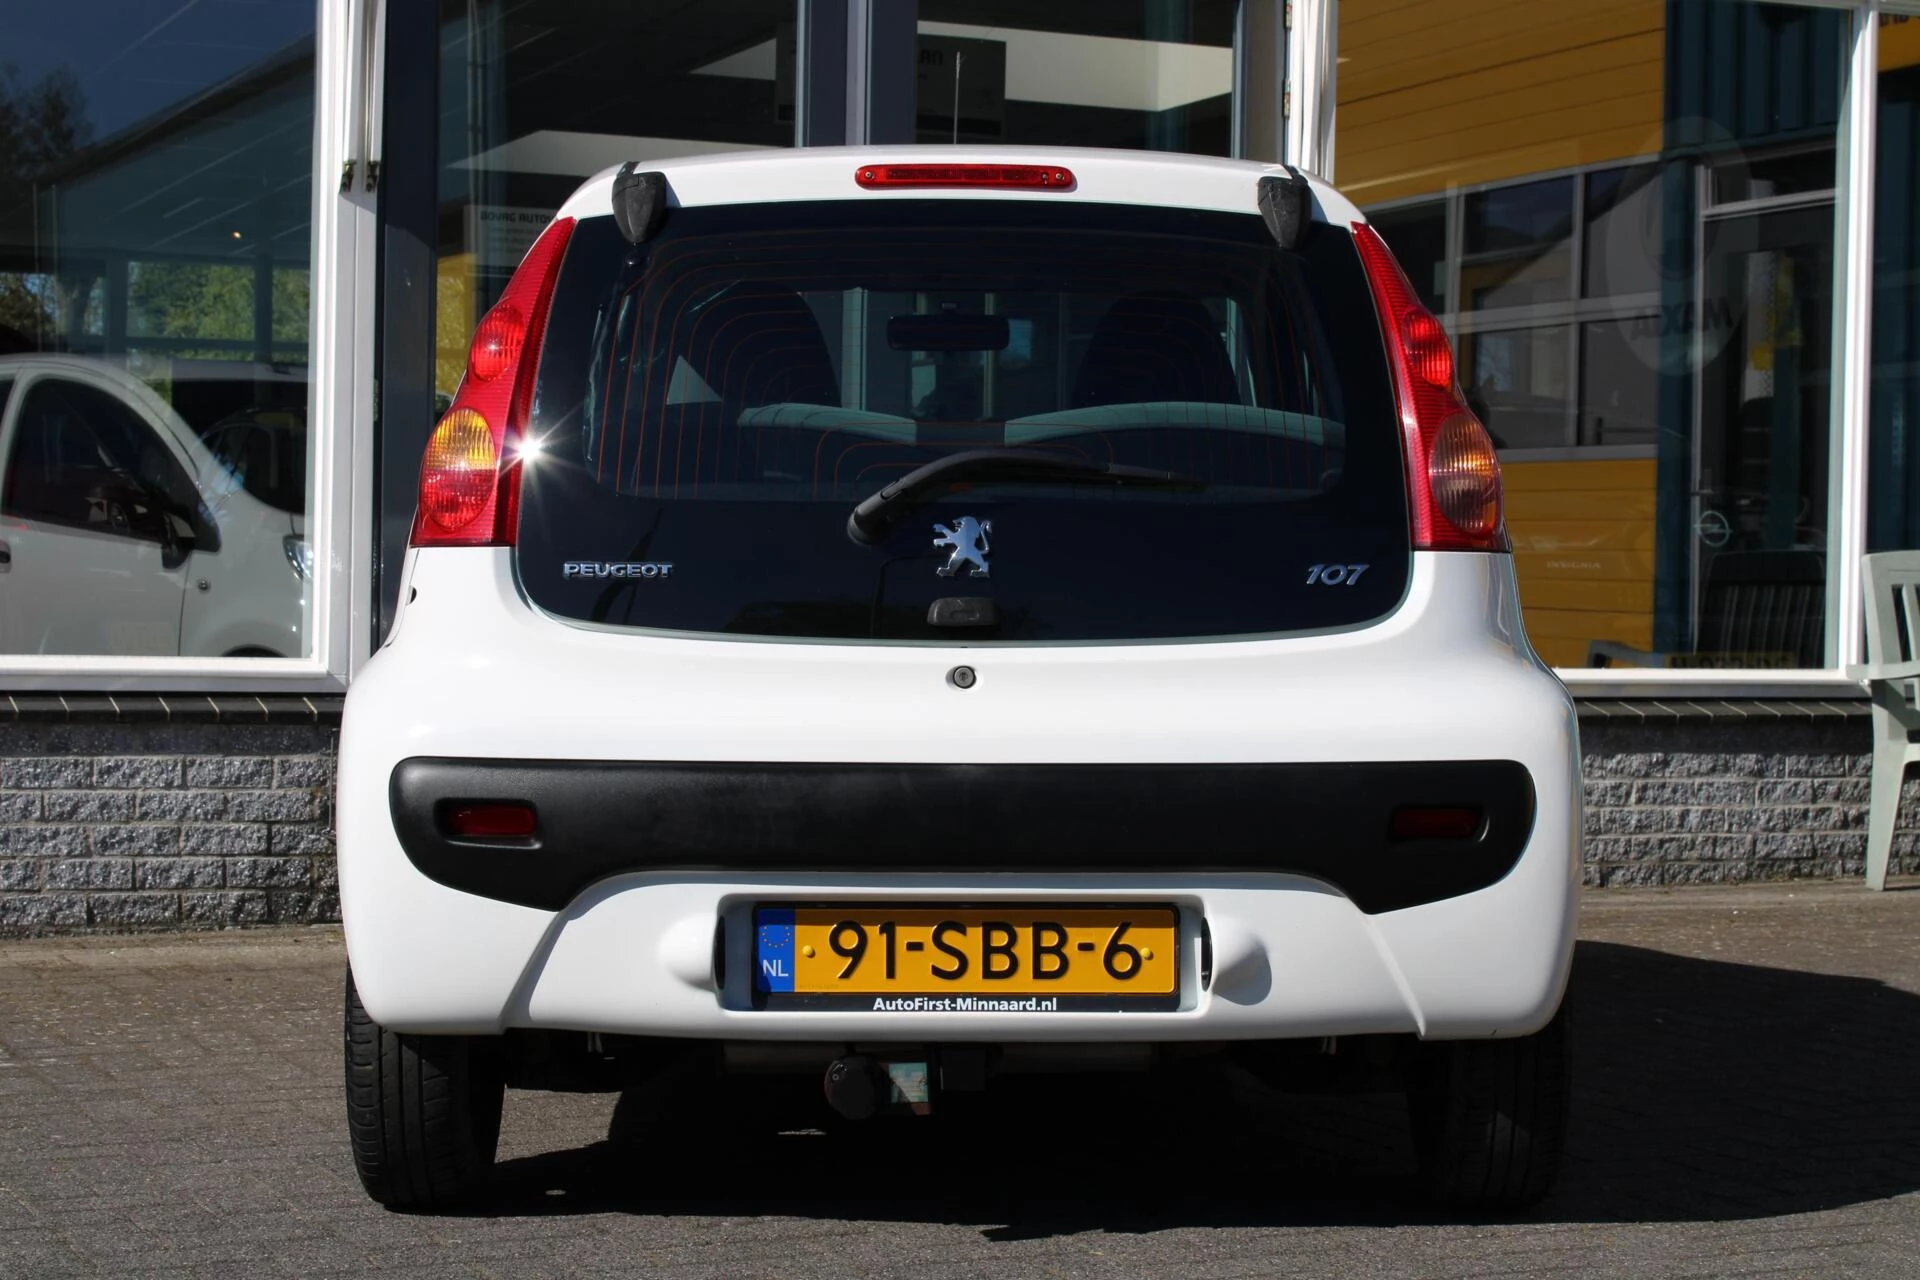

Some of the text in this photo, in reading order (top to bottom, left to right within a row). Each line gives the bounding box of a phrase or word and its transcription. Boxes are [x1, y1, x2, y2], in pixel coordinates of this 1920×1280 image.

[480, 210, 517, 223] BOVAG
[563, 562, 672, 578] PEUGEOT
[1306, 563, 1370, 586] 107
[828, 920, 1142, 980] 91-SBB-6
[763, 959, 789, 976] NL
[873, 997, 1057, 1011] AutoFirst-Minnaard.nl
